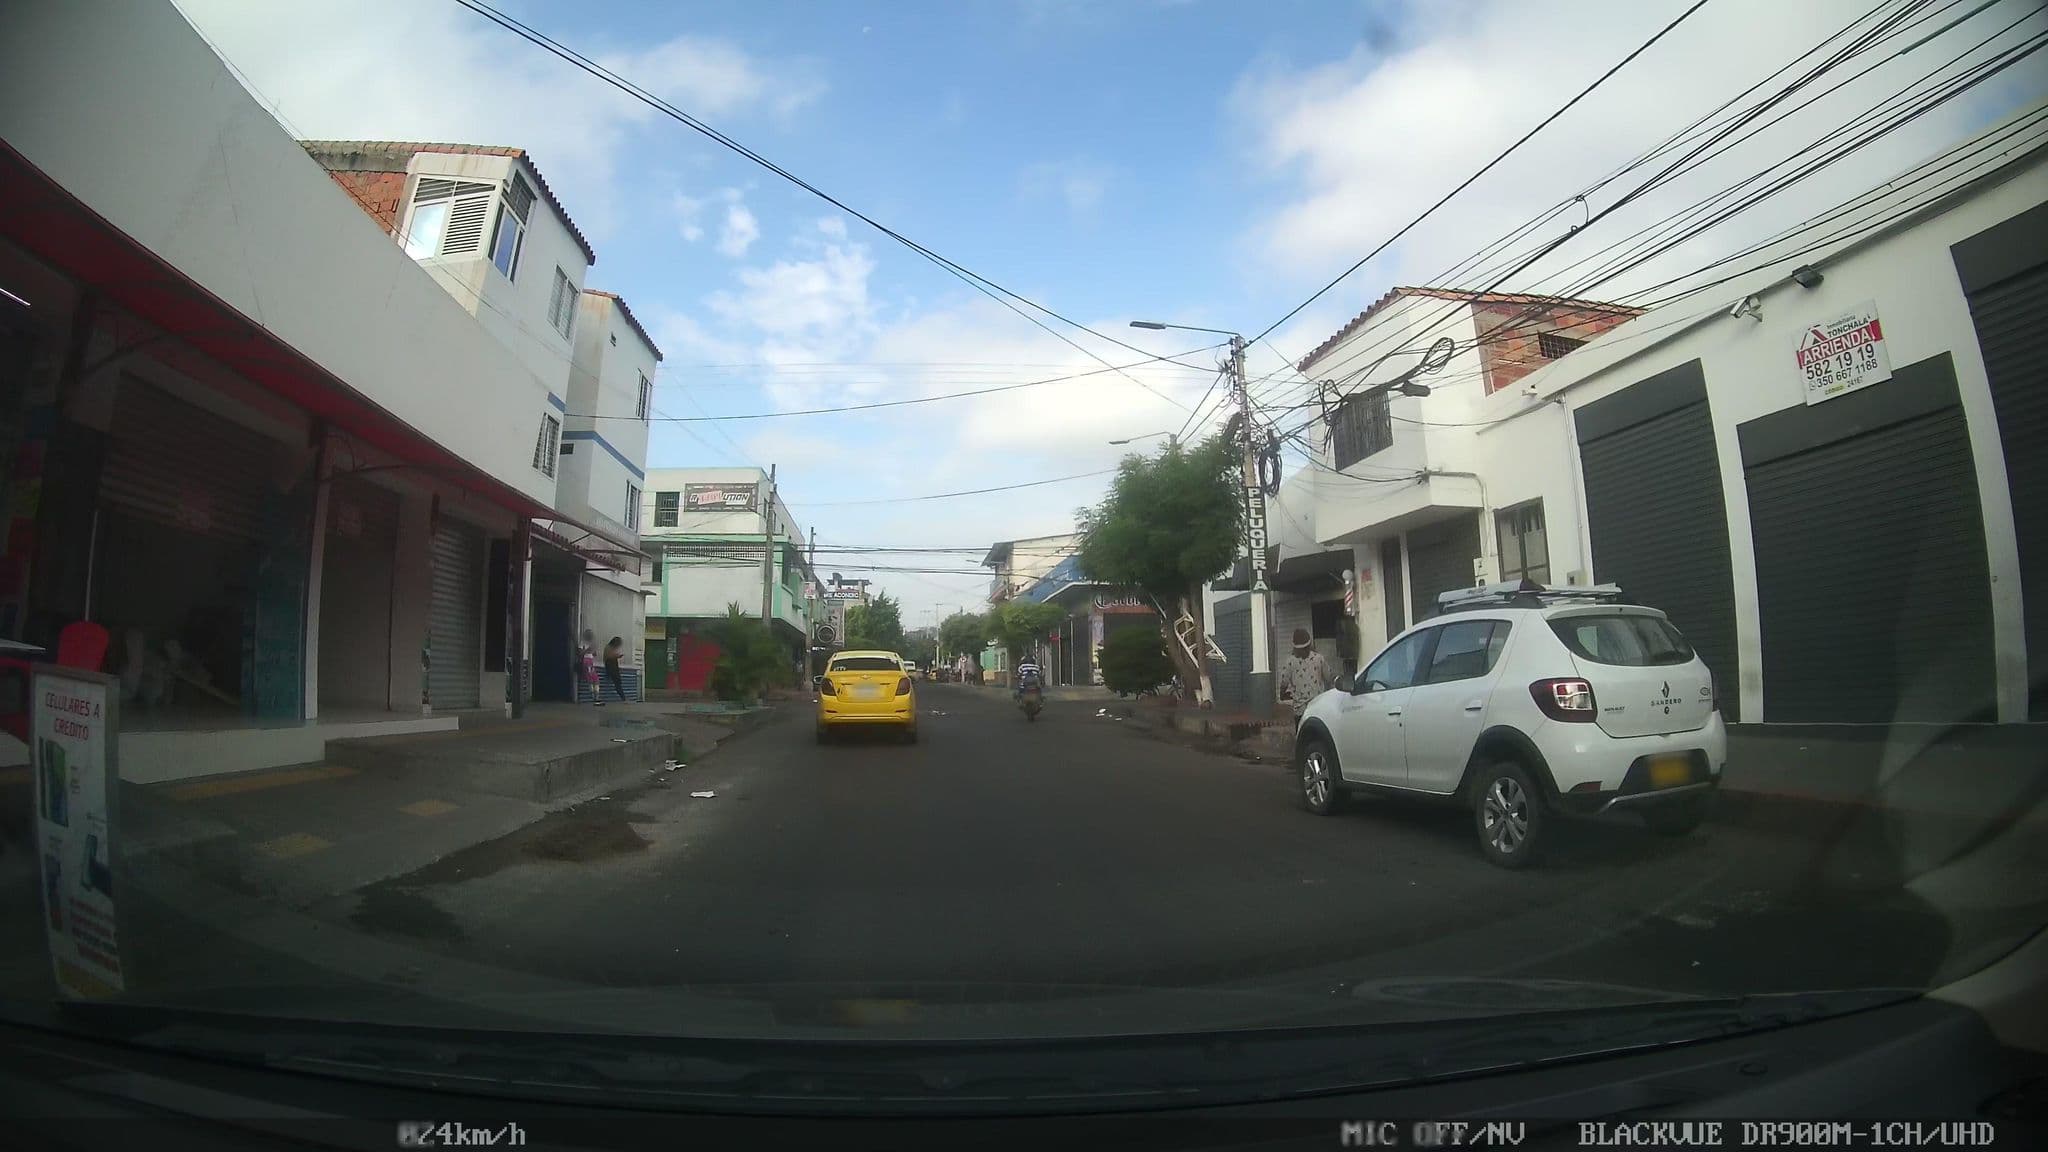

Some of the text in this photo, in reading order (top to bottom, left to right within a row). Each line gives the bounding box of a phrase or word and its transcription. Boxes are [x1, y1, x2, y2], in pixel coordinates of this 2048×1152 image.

[1806, 343, 1875, 380] 582 19 19
[1817, 359, 1878, 388] 350 667 1188
[1247, 487, 1268, 590] PELUQUERIA
[46, 692, 100, 718] CELULARES A
